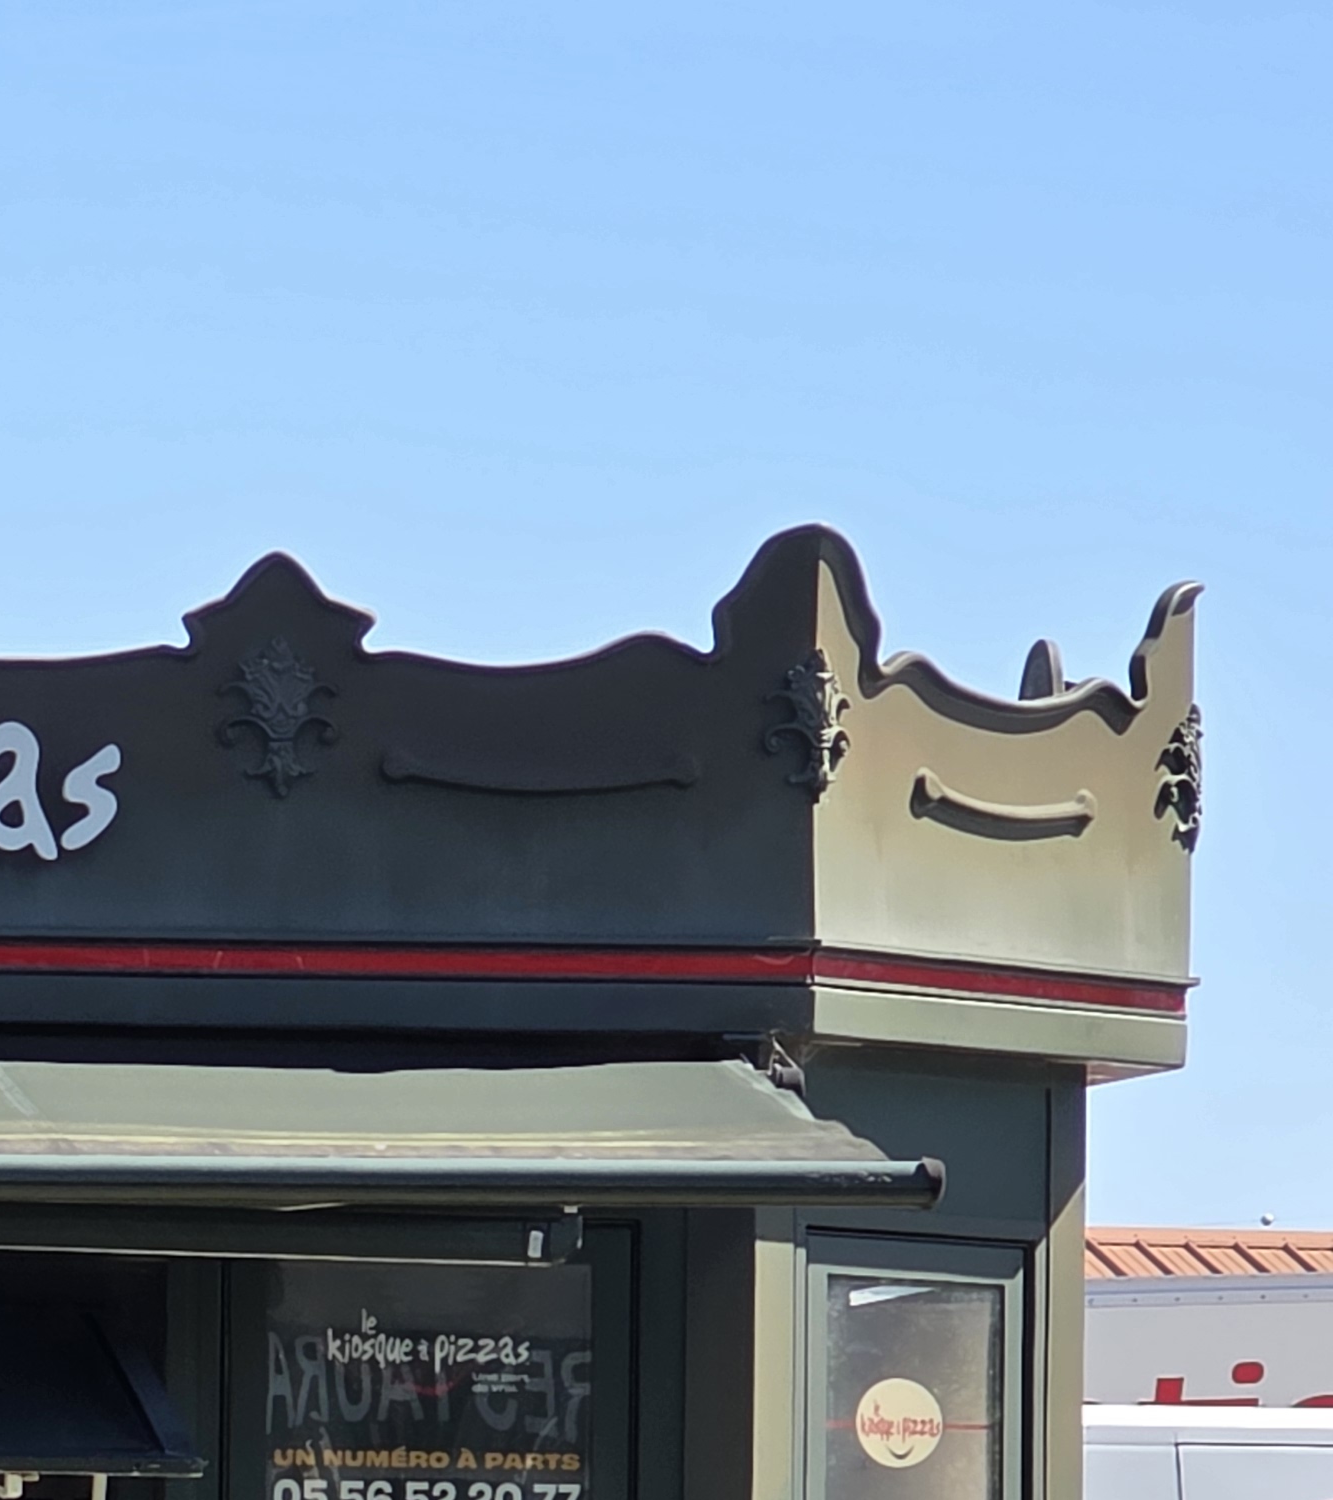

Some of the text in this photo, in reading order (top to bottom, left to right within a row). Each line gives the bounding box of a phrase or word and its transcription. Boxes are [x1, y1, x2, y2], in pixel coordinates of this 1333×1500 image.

[361, 1308, 377, 1334] le
[327, 1328, 413, 1369] kiosque
[434, 1336, 530, 1374] pizzas
[273, 1446, 581, 1470] UN NUMÉRO À PARTS
